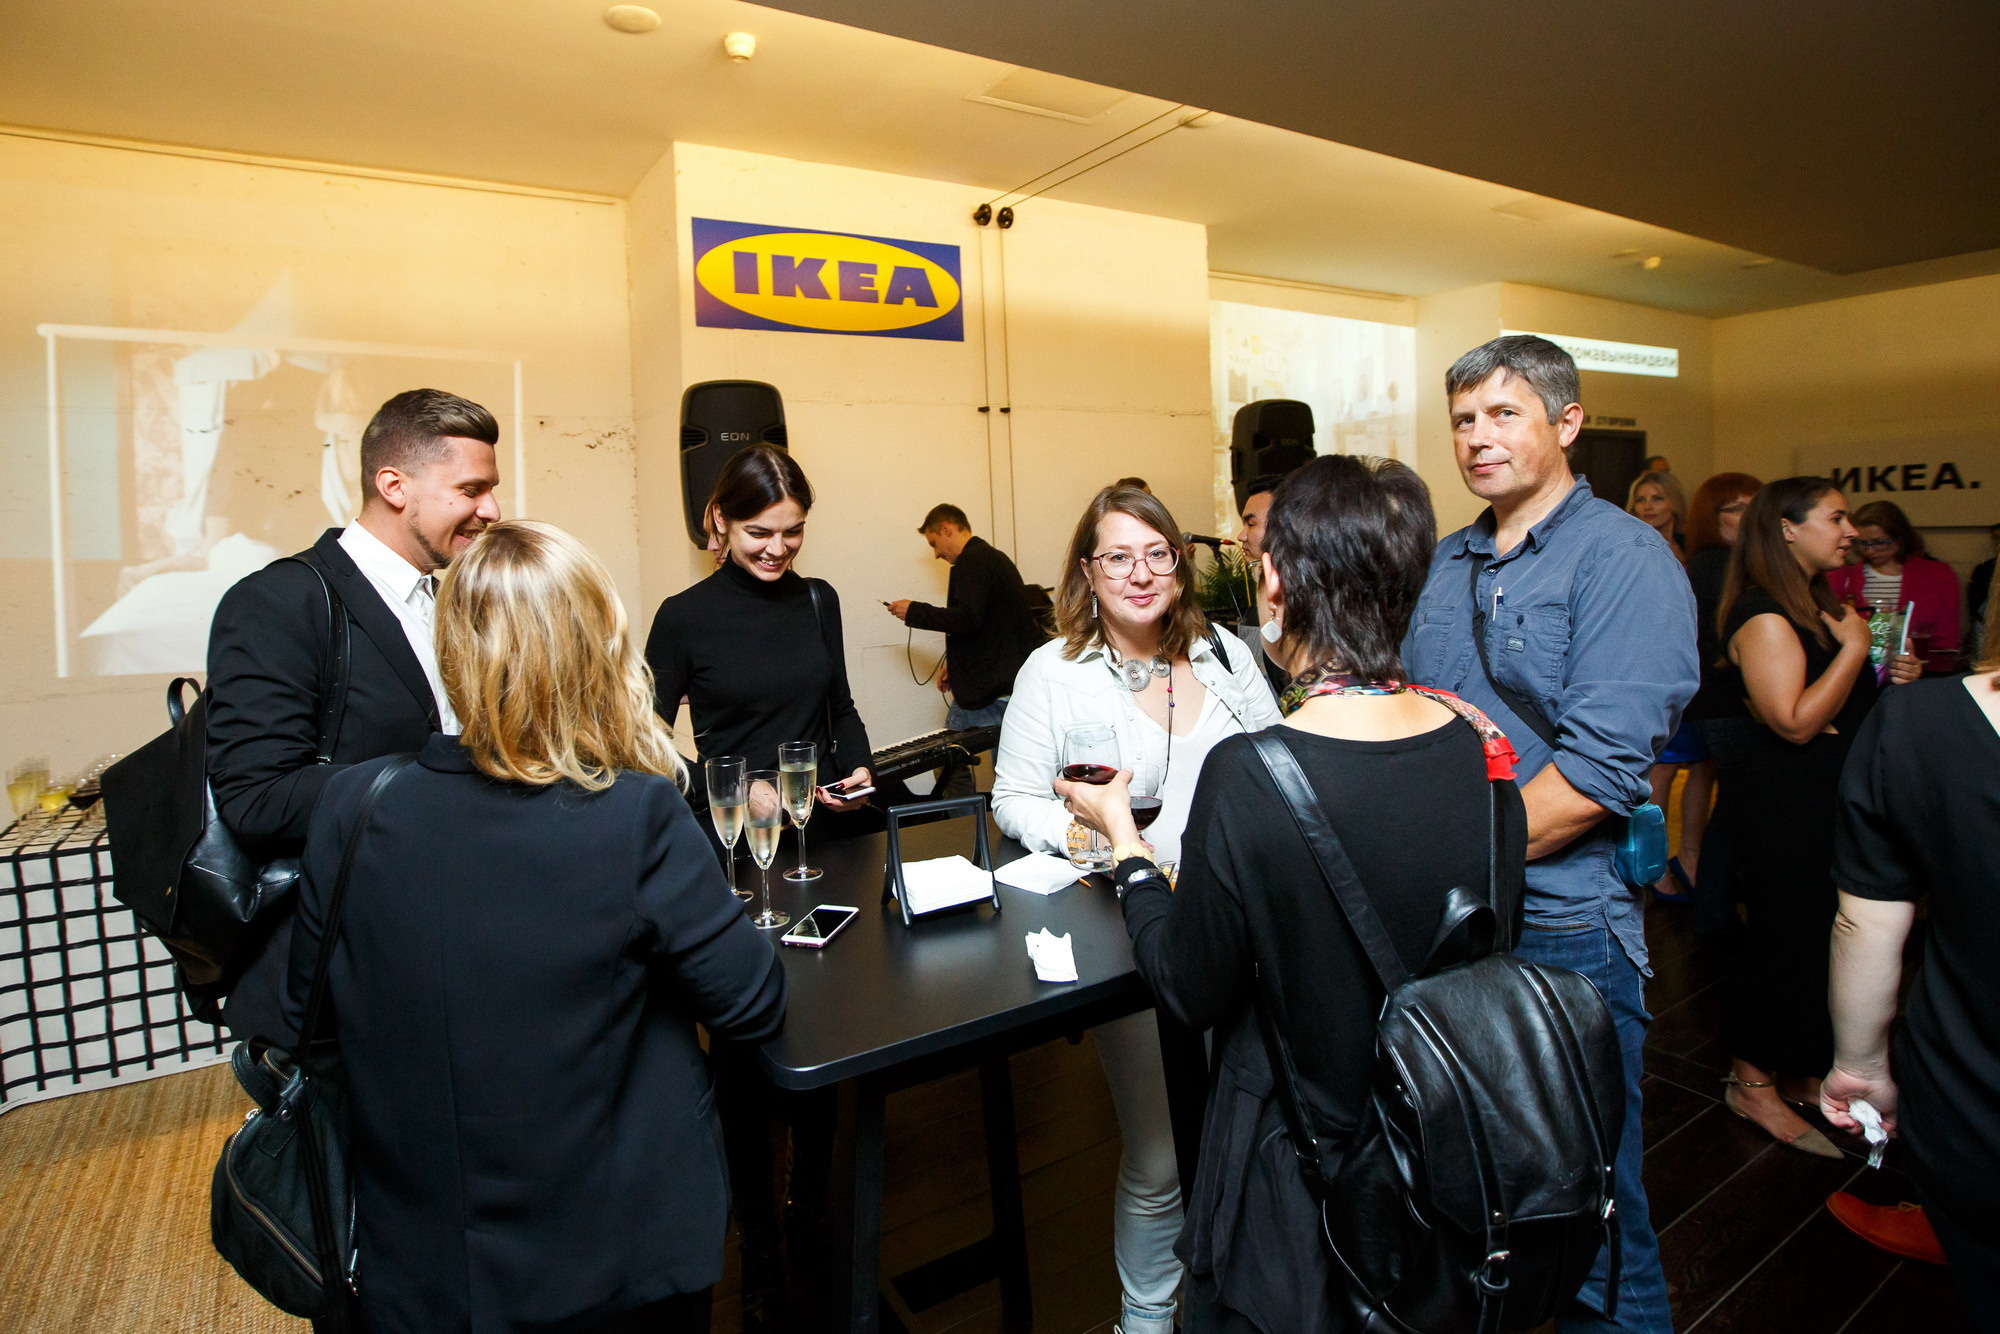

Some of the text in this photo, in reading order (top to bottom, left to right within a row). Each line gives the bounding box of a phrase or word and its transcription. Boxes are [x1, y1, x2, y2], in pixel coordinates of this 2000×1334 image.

[733, 251, 939, 308] IKEA
[720, 432, 750, 441] EON
[1831, 462, 1981, 492] ИКЕА.
